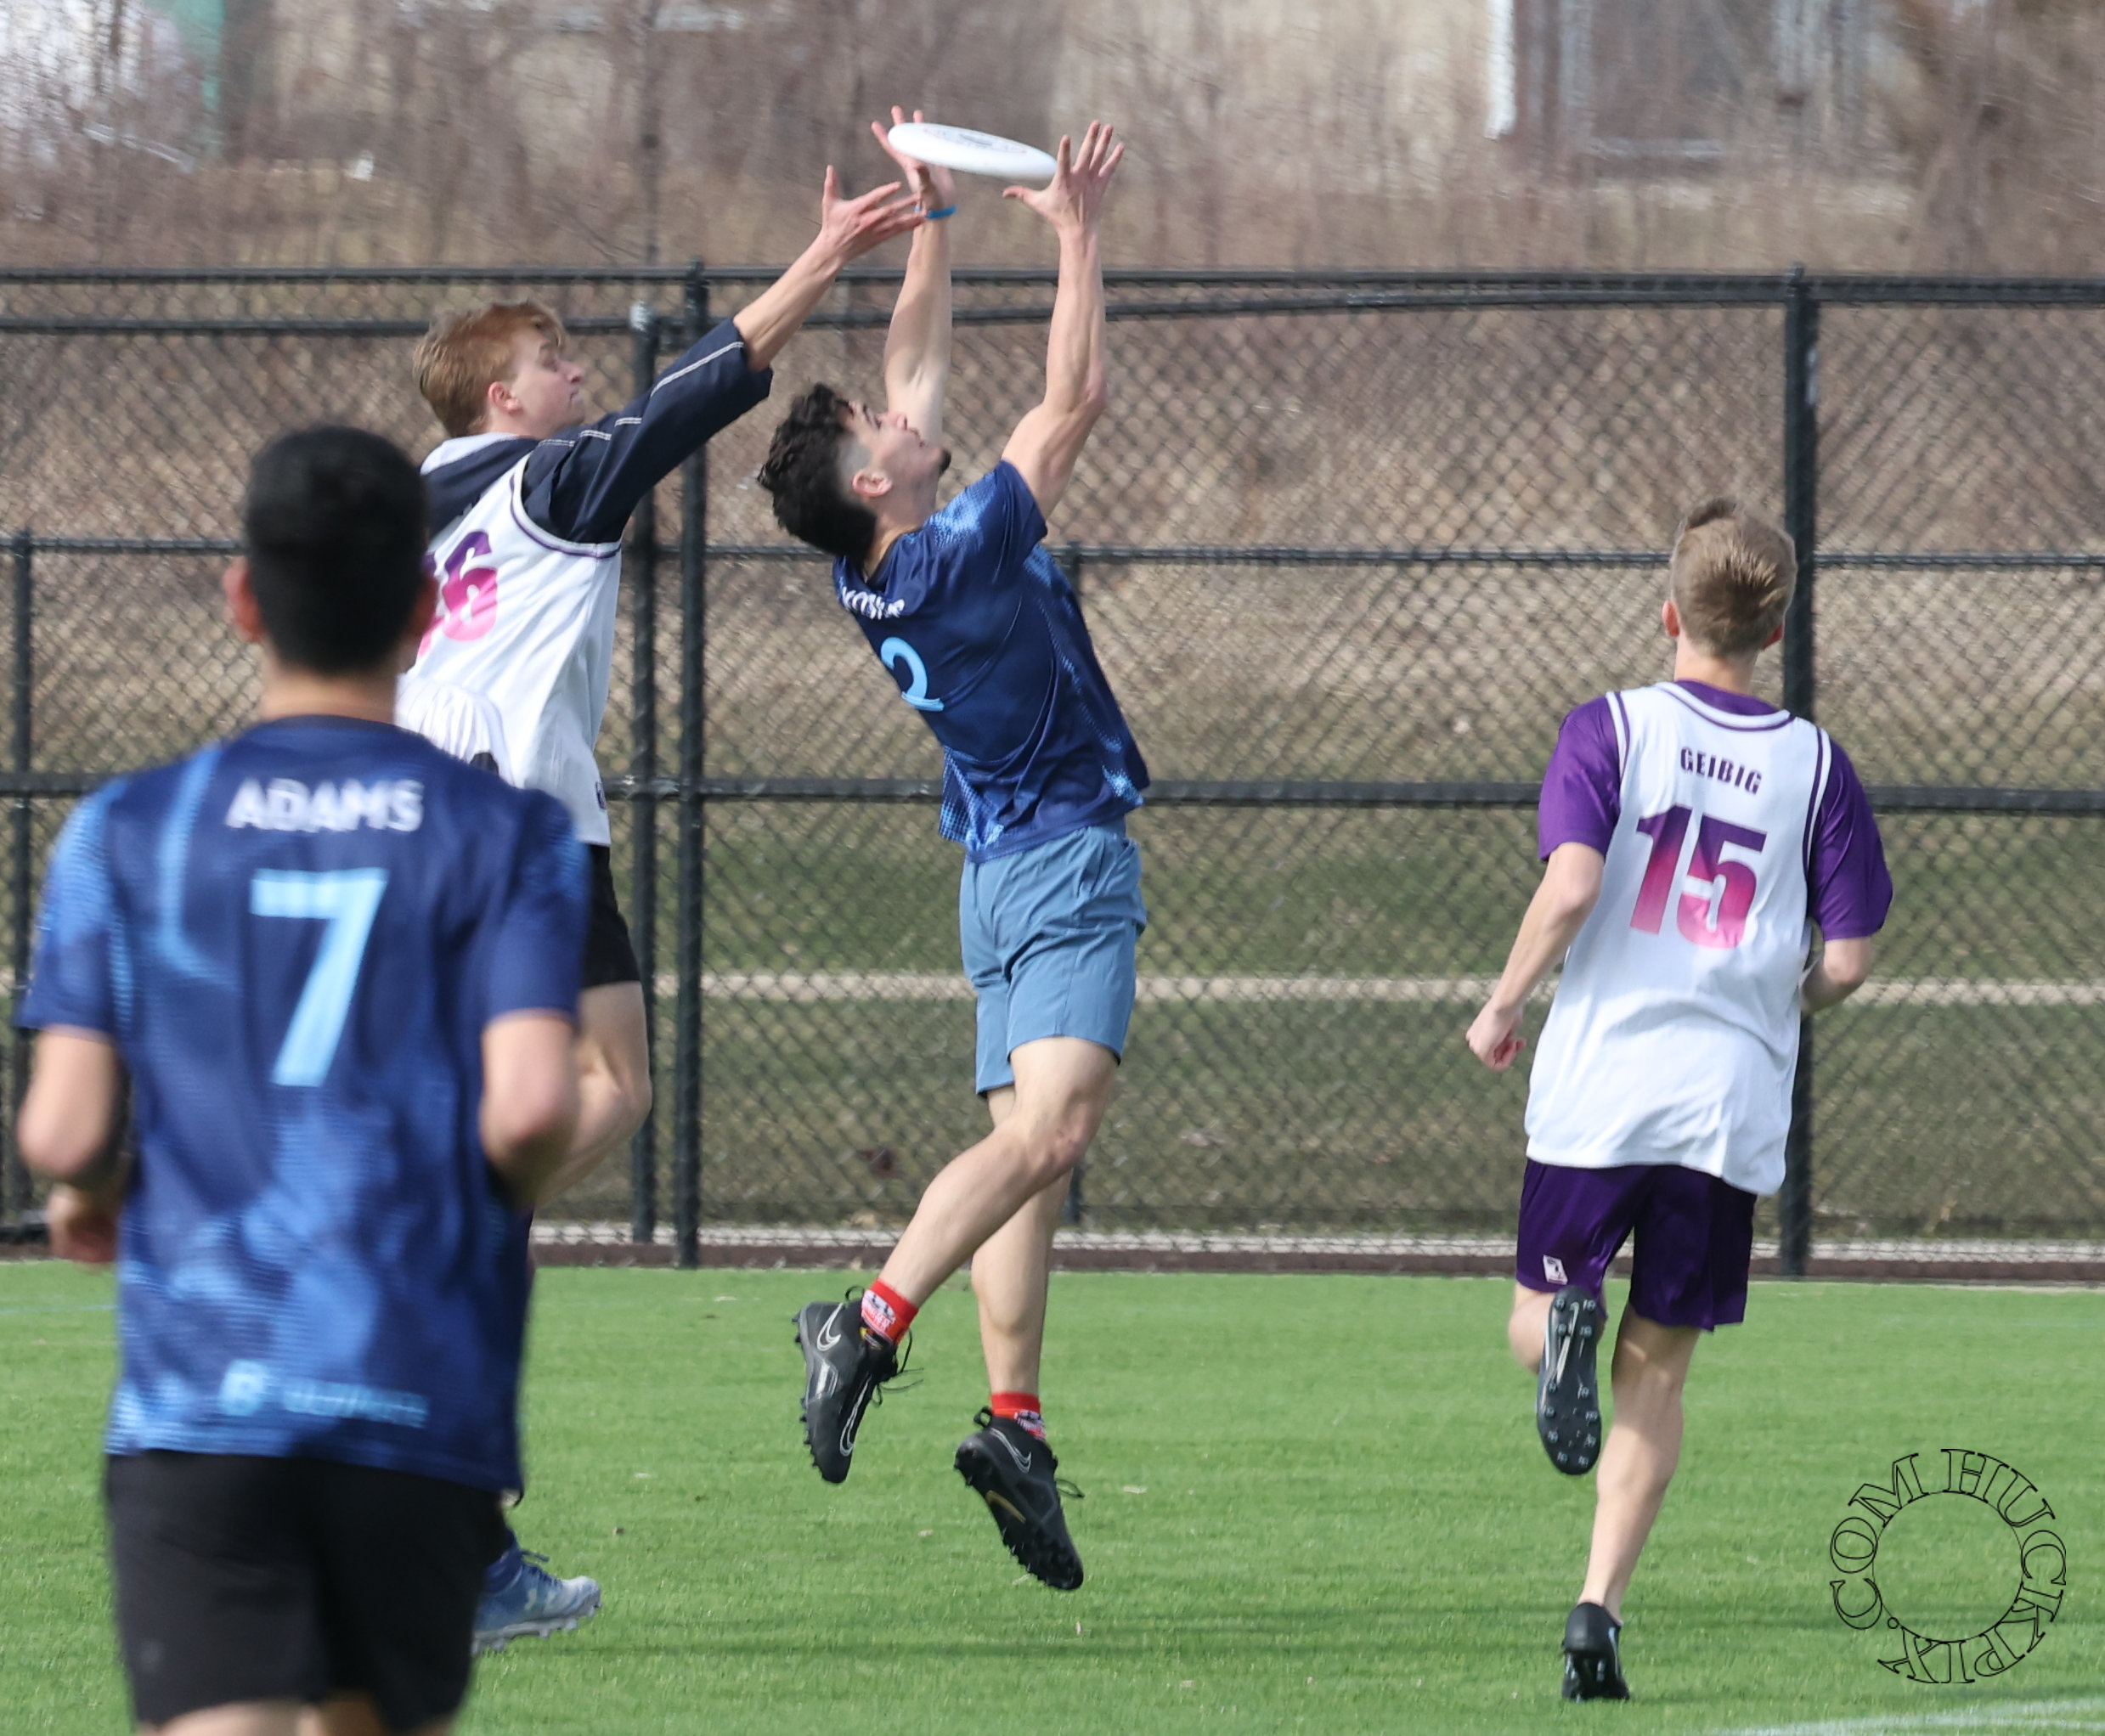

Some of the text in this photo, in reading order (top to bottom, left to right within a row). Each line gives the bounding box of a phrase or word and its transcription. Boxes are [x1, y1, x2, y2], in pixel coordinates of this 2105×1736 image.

[880, 636, 945, 713] 2
[224, 777, 426, 833] ADAMS
[1679, 746, 1764, 797] GEIBIG
[1628, 802, 1769, 951] 15
[249, 866, 389, 1088] 7
